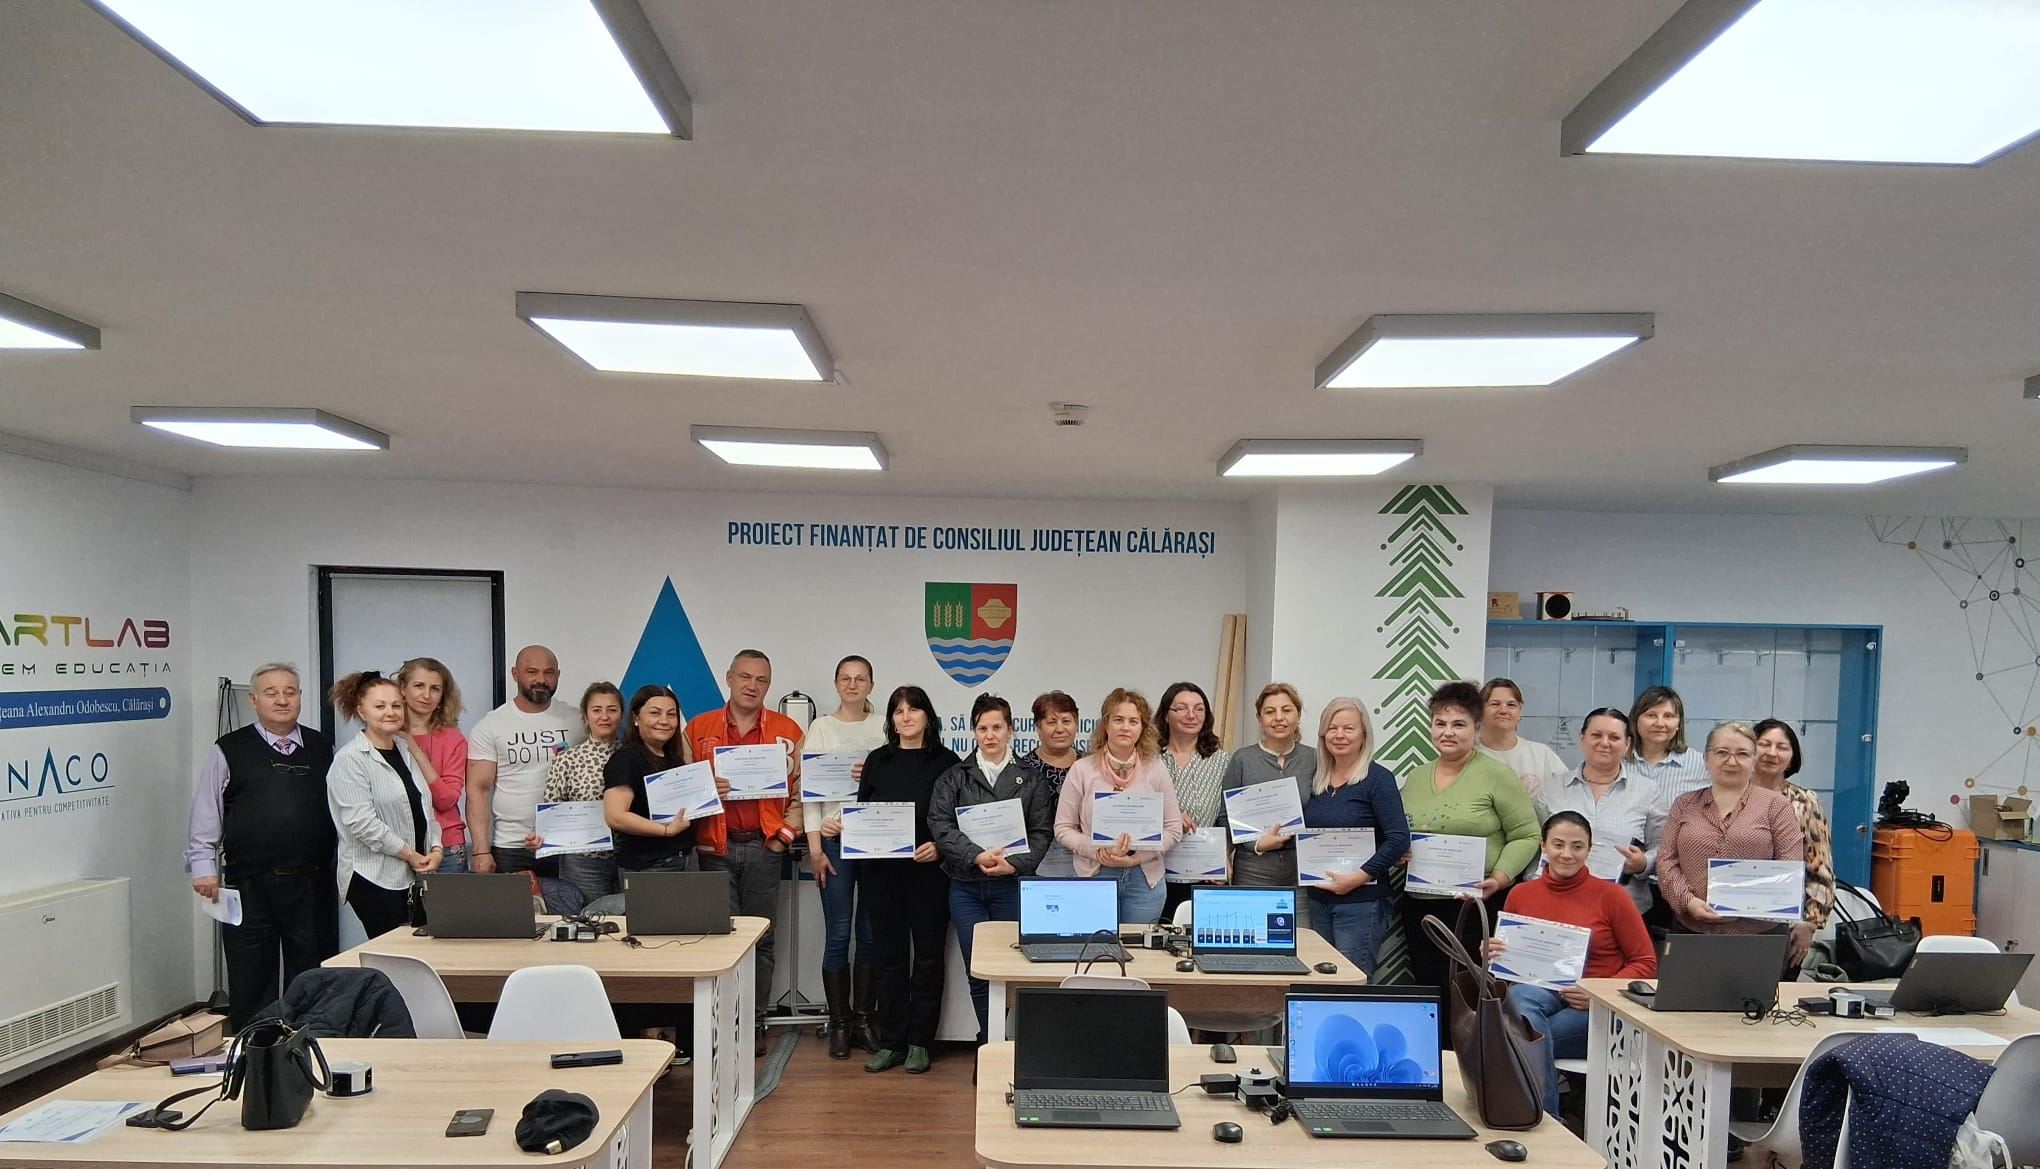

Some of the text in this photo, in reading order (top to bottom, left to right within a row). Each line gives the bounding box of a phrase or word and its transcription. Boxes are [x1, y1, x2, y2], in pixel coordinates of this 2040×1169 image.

[728, 521, 1216, 558] PROIECT FINANȚAT DE CONSILIUL JUDEȚEAN CĂLĂRAȘI
[55, 662, 172, 678] EDUCAȚIA
[26, 700, 75, 717] Alexandru
[76, 699, 120, 715] Odobescu,
[122, 697, 154, 713] Călărași
[951, 713, 966, 731] SĂ
[507, 729, 569, 746] JUST
[952, 737, 968, 752] NU
[507, 745, 553, 765] DO IT
[24, 801, 52, 817] PENTRU
[54, 796, 110, 813] COMPETITIVITATE
